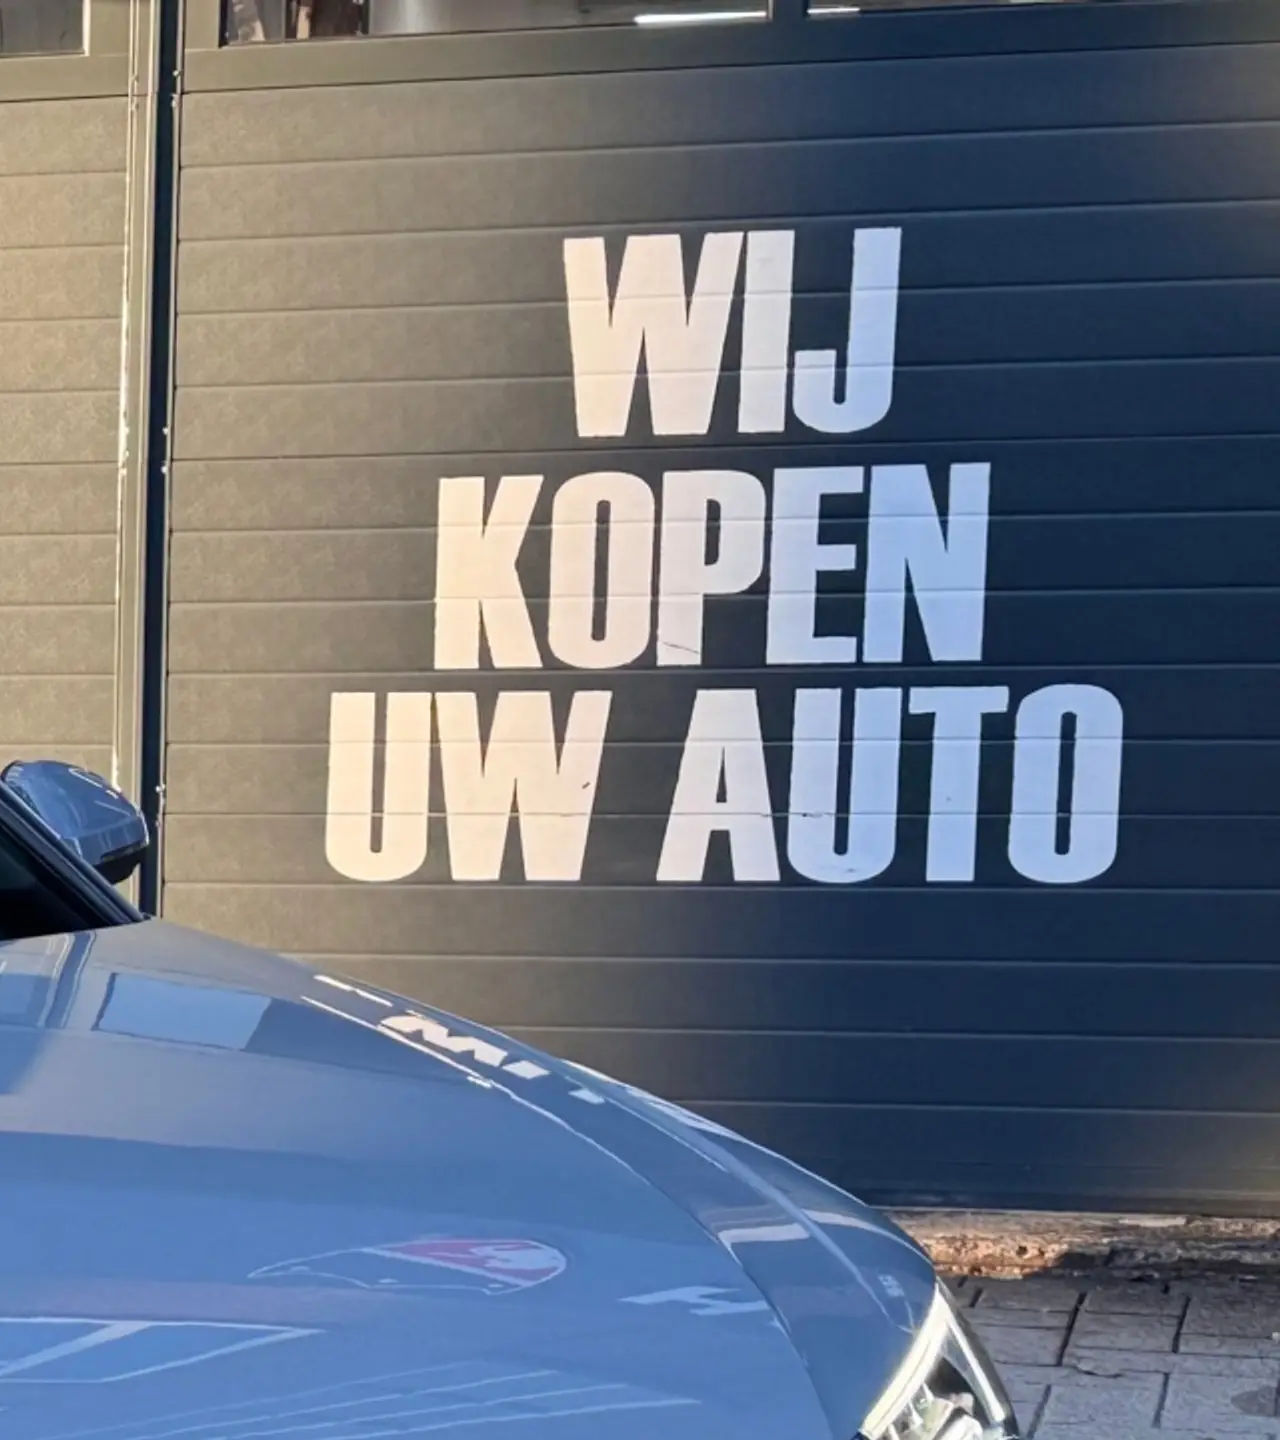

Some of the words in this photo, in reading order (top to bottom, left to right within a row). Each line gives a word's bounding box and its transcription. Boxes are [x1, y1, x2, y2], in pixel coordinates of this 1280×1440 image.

[563, 227, 902, 438] WIJ
[433, 462, 992, 670] KOPEN
[325, 690, 614, 882] UW
[655, 684, 1125, 883] AUTO
